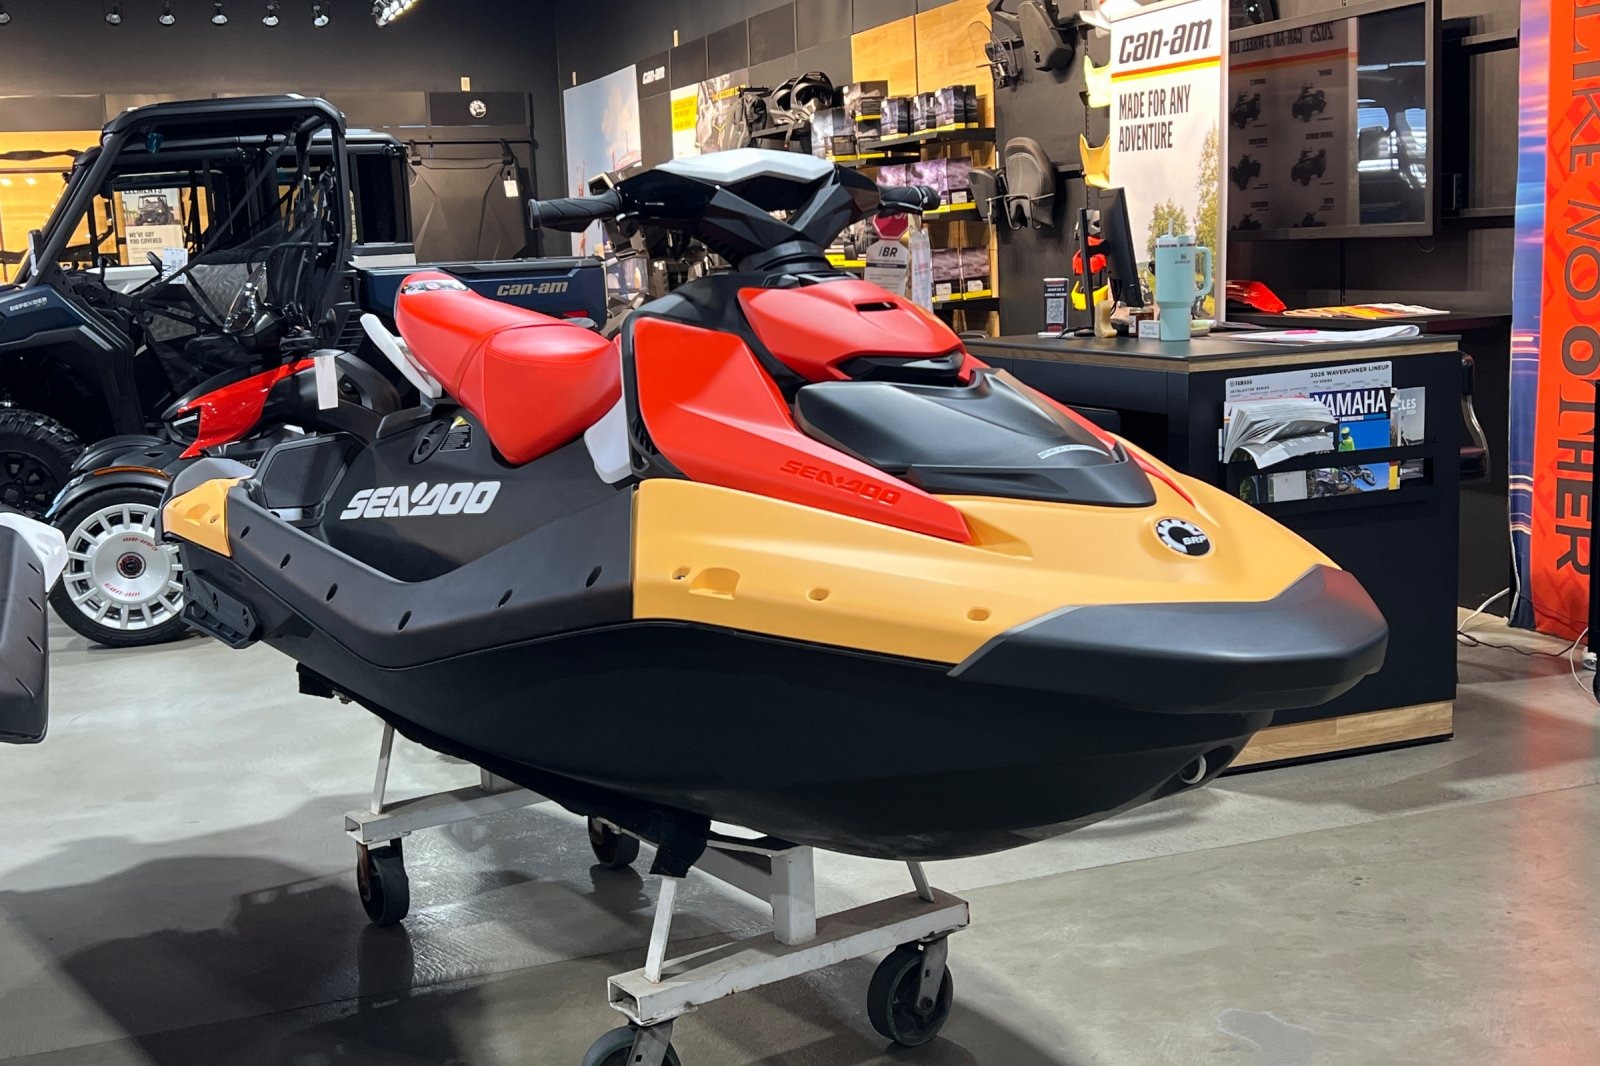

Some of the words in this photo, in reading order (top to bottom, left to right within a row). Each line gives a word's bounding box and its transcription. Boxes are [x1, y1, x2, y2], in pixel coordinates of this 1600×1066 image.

[1118, 18, 1212, 64] can-am
[1119, 91, 1145, 120] MADE
[1148, 88, 1166, 118] FOR
[1169, 84, 1191, 115] ANY
[1569, 0, 1600, 173] LIKE
[1118, 121, 1173, 153] ADVENTURE
[1564, 199, 1600, 301] NO
[9, 296, 48, 312] DEFENDER
[496, 281, 569, 297] can-am
[1326, 367, 1367, 376] WAVERUNNER
[1368, 364, 1390, 372] LINEUP
[1314, 389, 1388, 417] YAMAHA
[1555, 325, 1600, 575] OTHER
[1182, 534, 1208, 546] BRP
